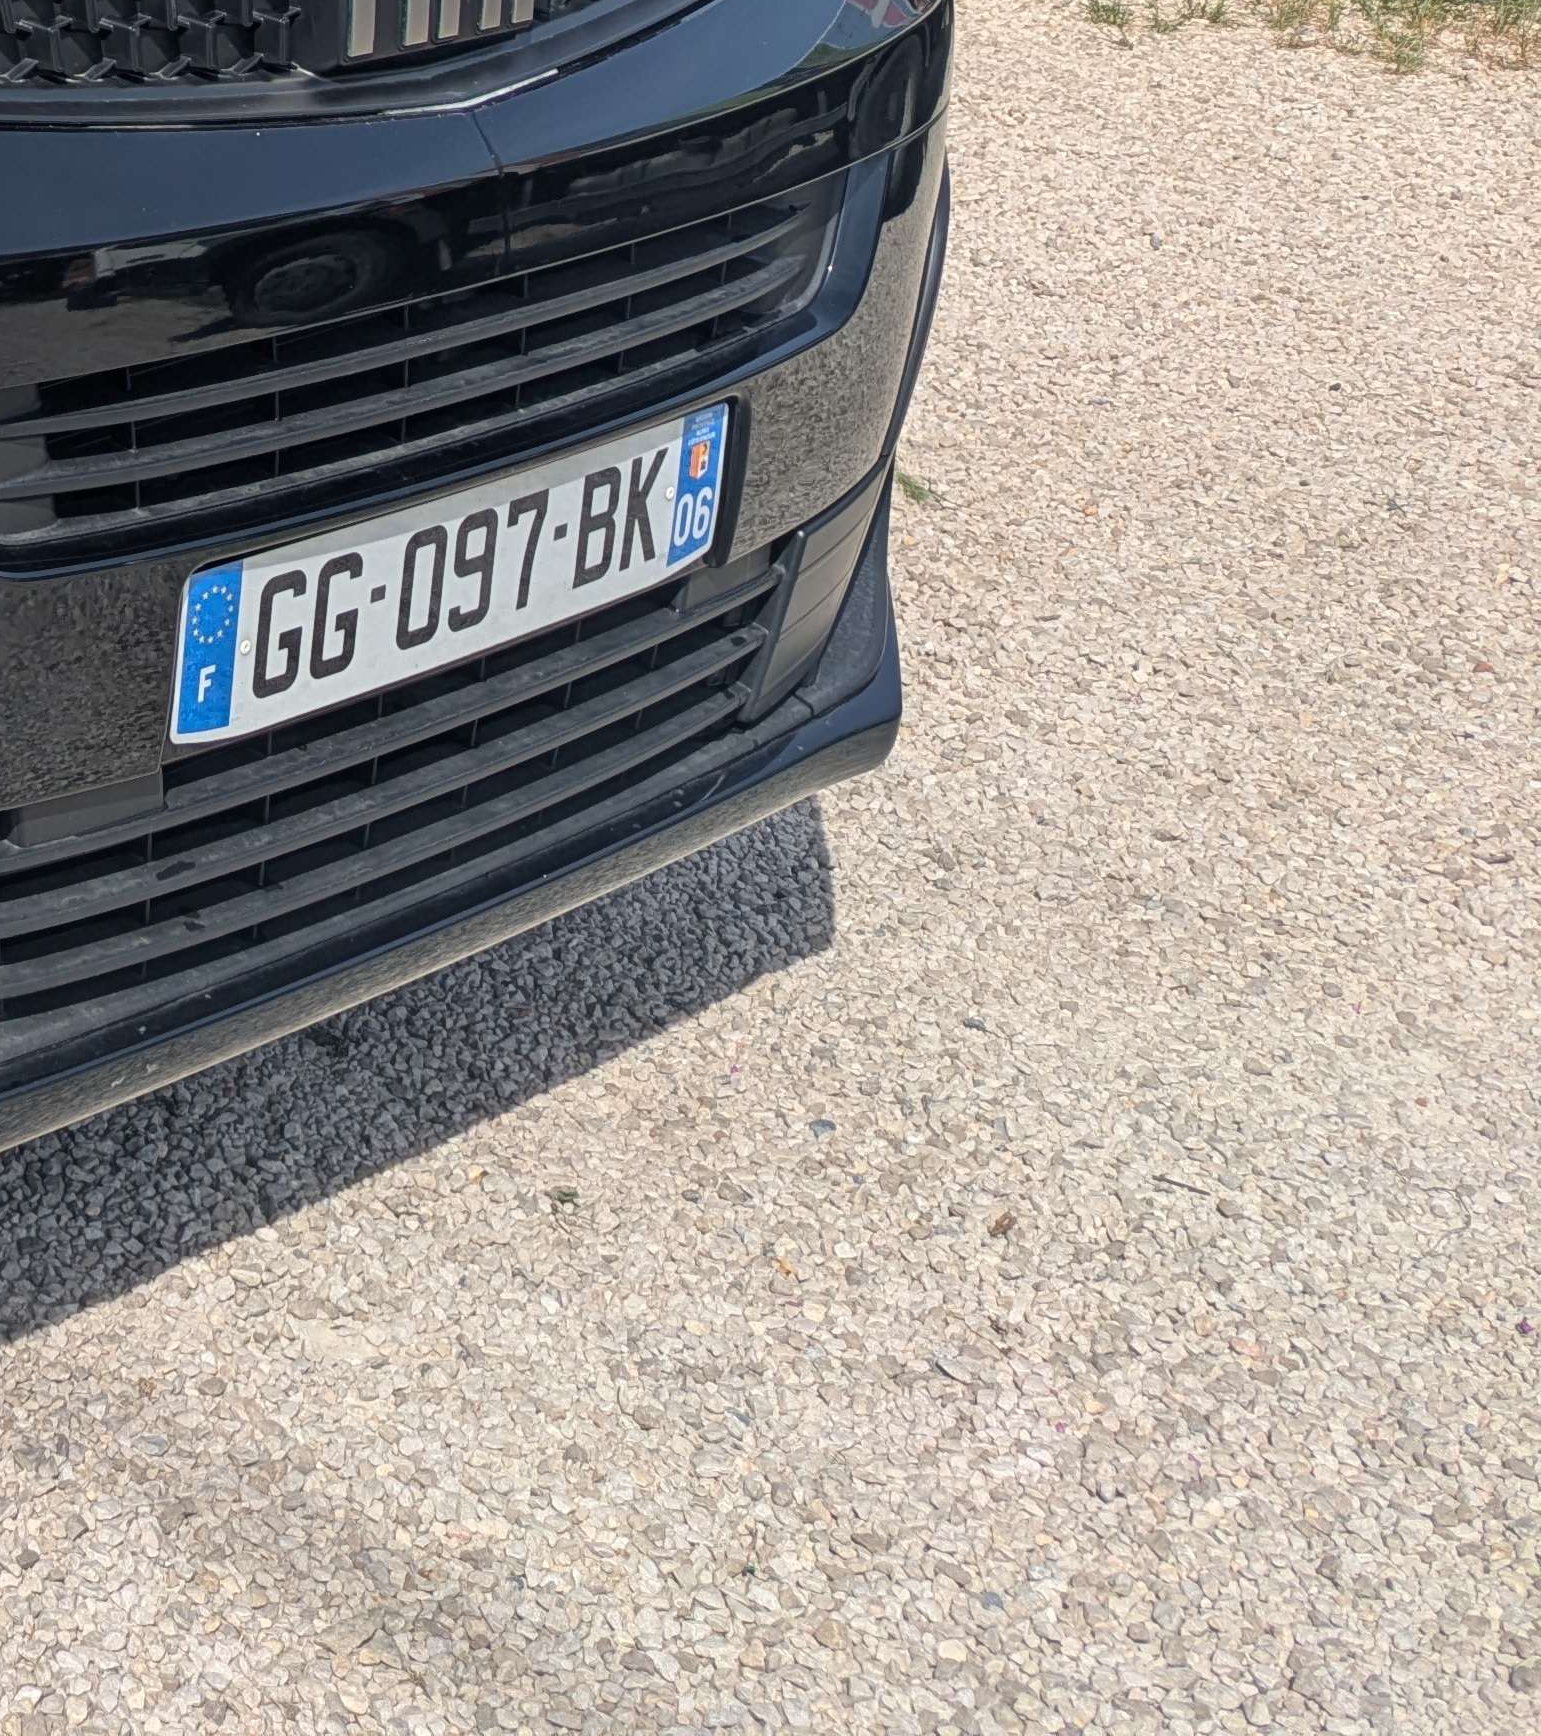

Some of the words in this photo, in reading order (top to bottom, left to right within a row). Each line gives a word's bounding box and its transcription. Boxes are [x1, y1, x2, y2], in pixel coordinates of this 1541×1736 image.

[673, 485, 713, 547] 06
[251, 446, 669, 700] GG-097-BK
[197, 664, 217, 704] F
